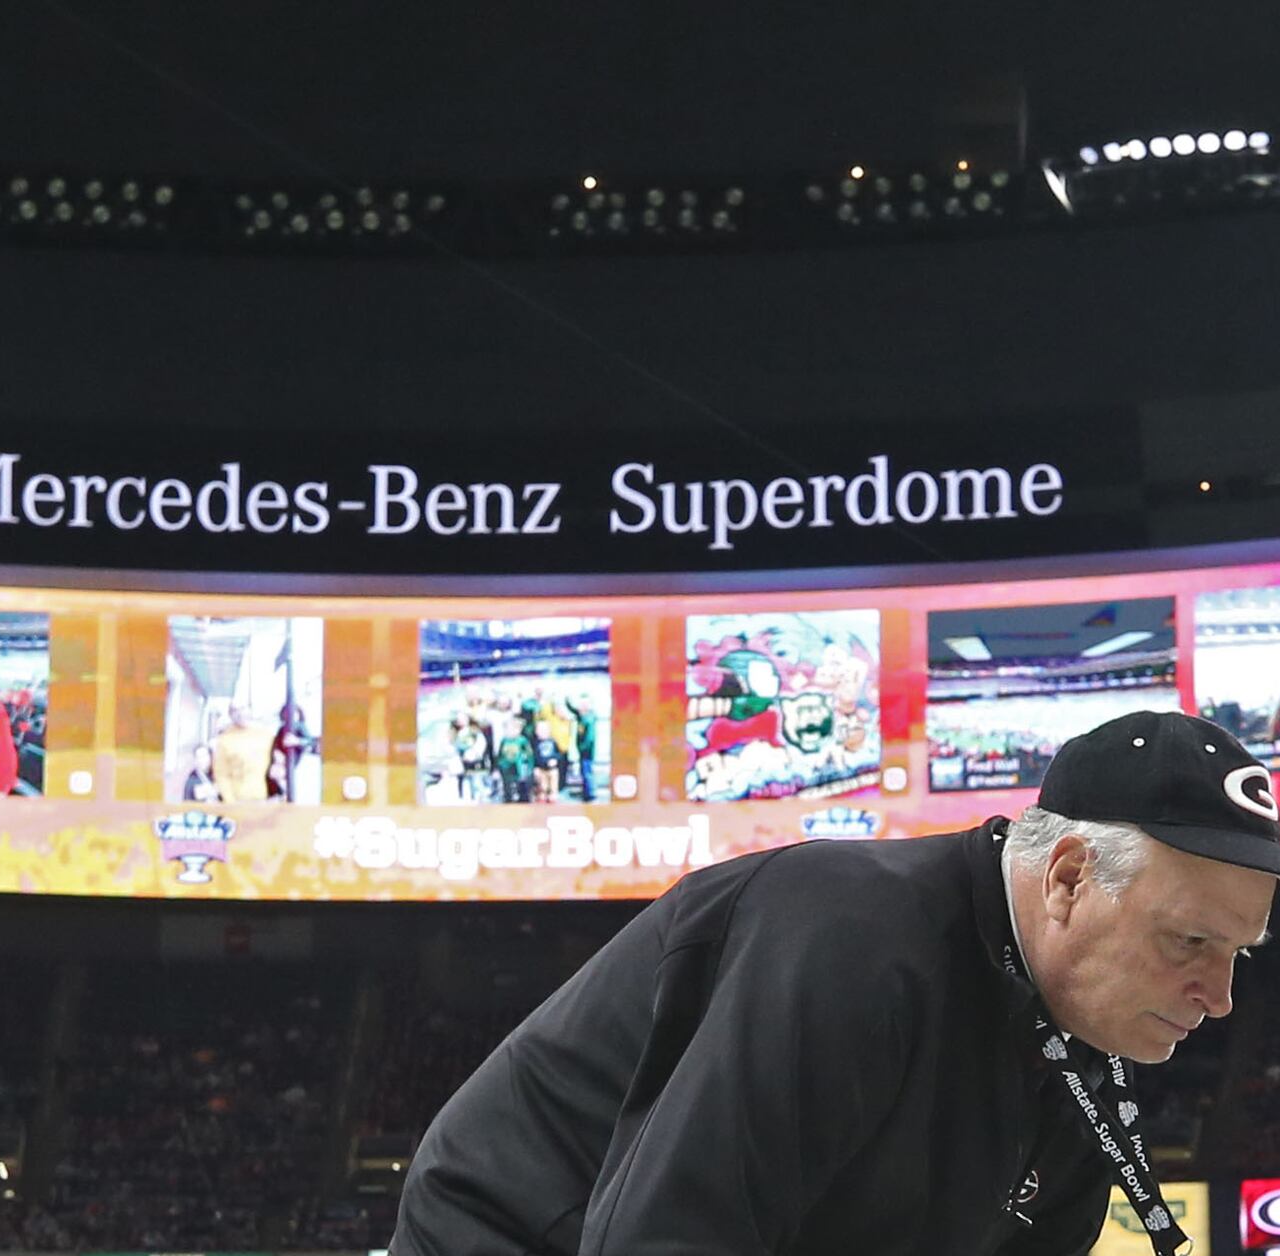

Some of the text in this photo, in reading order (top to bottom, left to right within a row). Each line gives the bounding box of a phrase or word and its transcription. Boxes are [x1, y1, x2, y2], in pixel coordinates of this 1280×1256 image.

[610, 455, 1063, 550] Superdome
[314, 814, 713, 881] #SugarBowl
[1094, 1122, 1126, 1164] Sugar
[1120, 1163, 1151, 1202] Bowl
